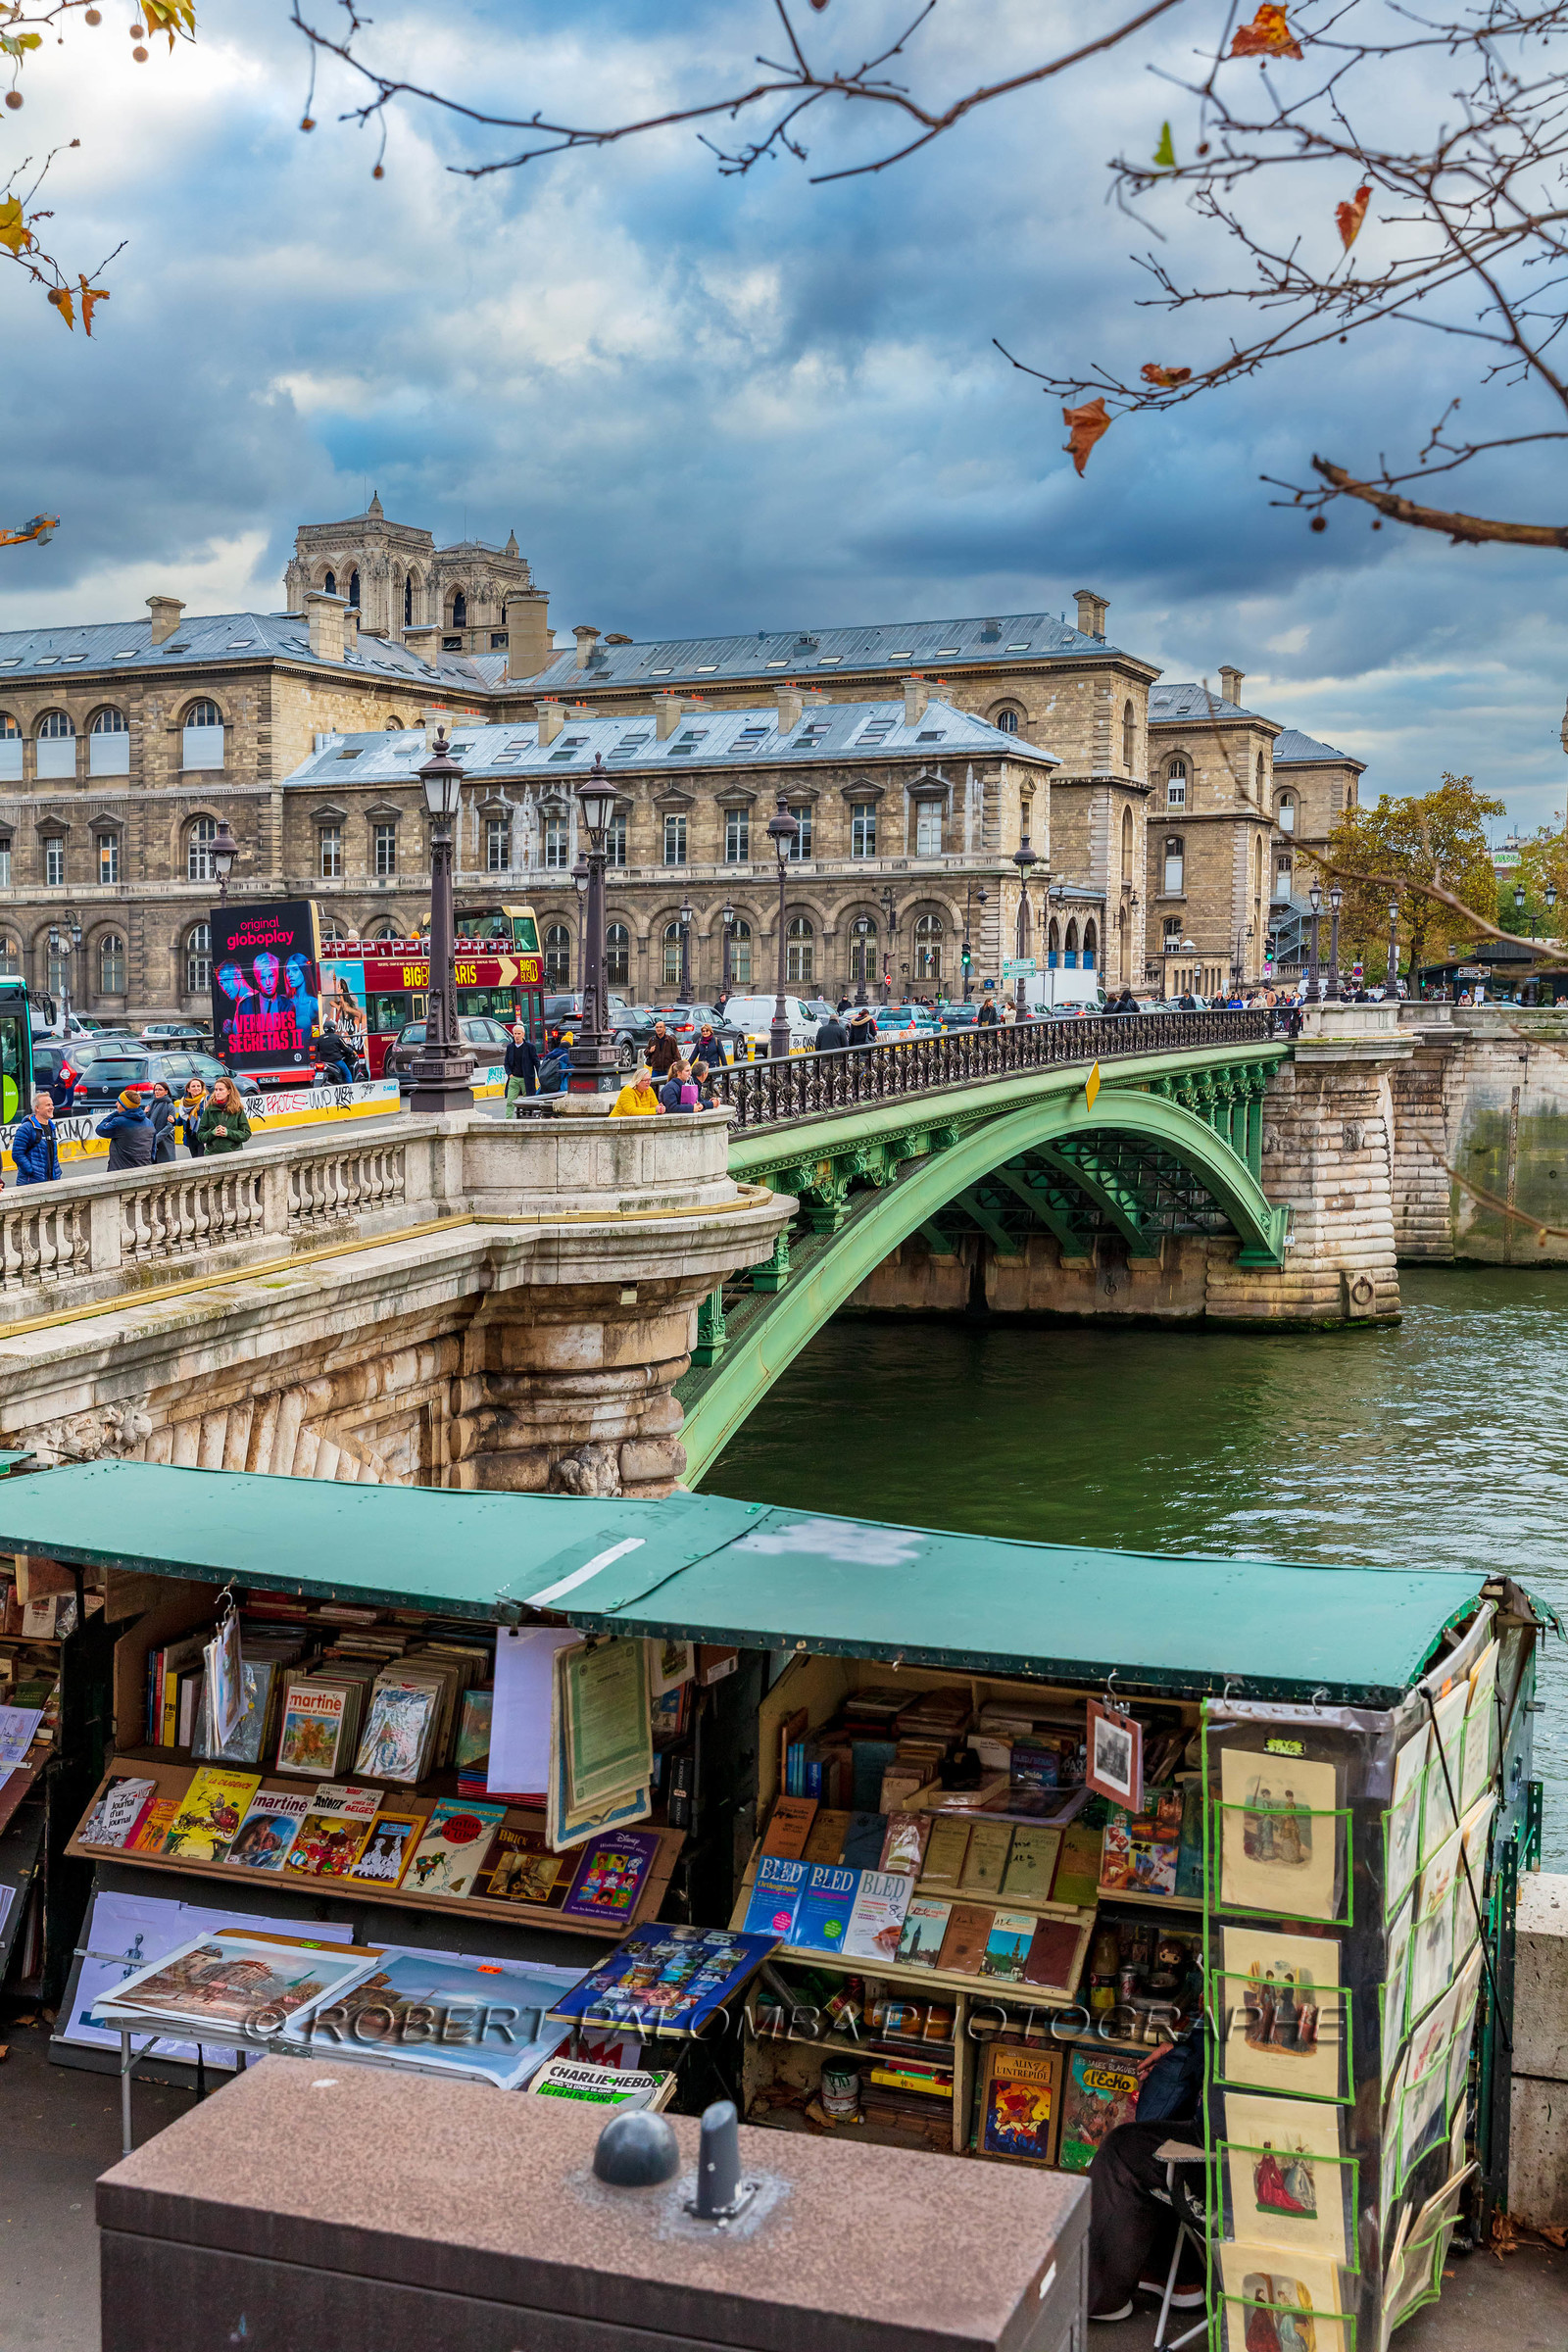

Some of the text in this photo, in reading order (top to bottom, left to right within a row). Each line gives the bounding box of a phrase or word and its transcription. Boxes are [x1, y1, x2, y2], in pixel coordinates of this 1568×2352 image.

[240, 915, 280, 931] original
[226, 931, 294, 951] globoplay
[520, 959, 530, 972] BIG
[521, 971, 530, 982] BUS
[235, 1011, 296, 1033] VERDADES
[228, 1031, 290, 1054] SECRETAS
[291, 1029, 304, 1050] II
[165, 1703, 176, 1712] FBI
[289, 1692, 342, 1711] martine
[1024, 1770, 1043, 1779] Guide
[218, 1779, 253, 1789] DILIGENCE
[112, 1798, 135, 1810] Journal
[253, 1796, 308, 1813] martine
[345, 1805, 375, 1814] BELGES
[110, 1810, 124, 1818] d'un
[108, 1815, 132, 1828] journal
[444, 1817, 480, 1829] Tintin
[499, 1829, 528, 1846] BRICK
[616, 1832, 640, 1846] Disney
[760, 1858, 803, 1883] BLED
[810, 1866, 854, 1891] BLED
[862, 1872, 906, 1899] BLED
[757, 1880, 798, 1893] Orthographe
[1013, 2059, 1034, 2069] ALIX
[1075, 2057, 1136, 2075] LES SALES BLAGUES
[549, 2066, 610, 2084] CHARLIE
[552, 2088, 573, 2097] FILM
[574, 2090, 586, 2098] DE
[587, 2093, 613, 2102] CONS
